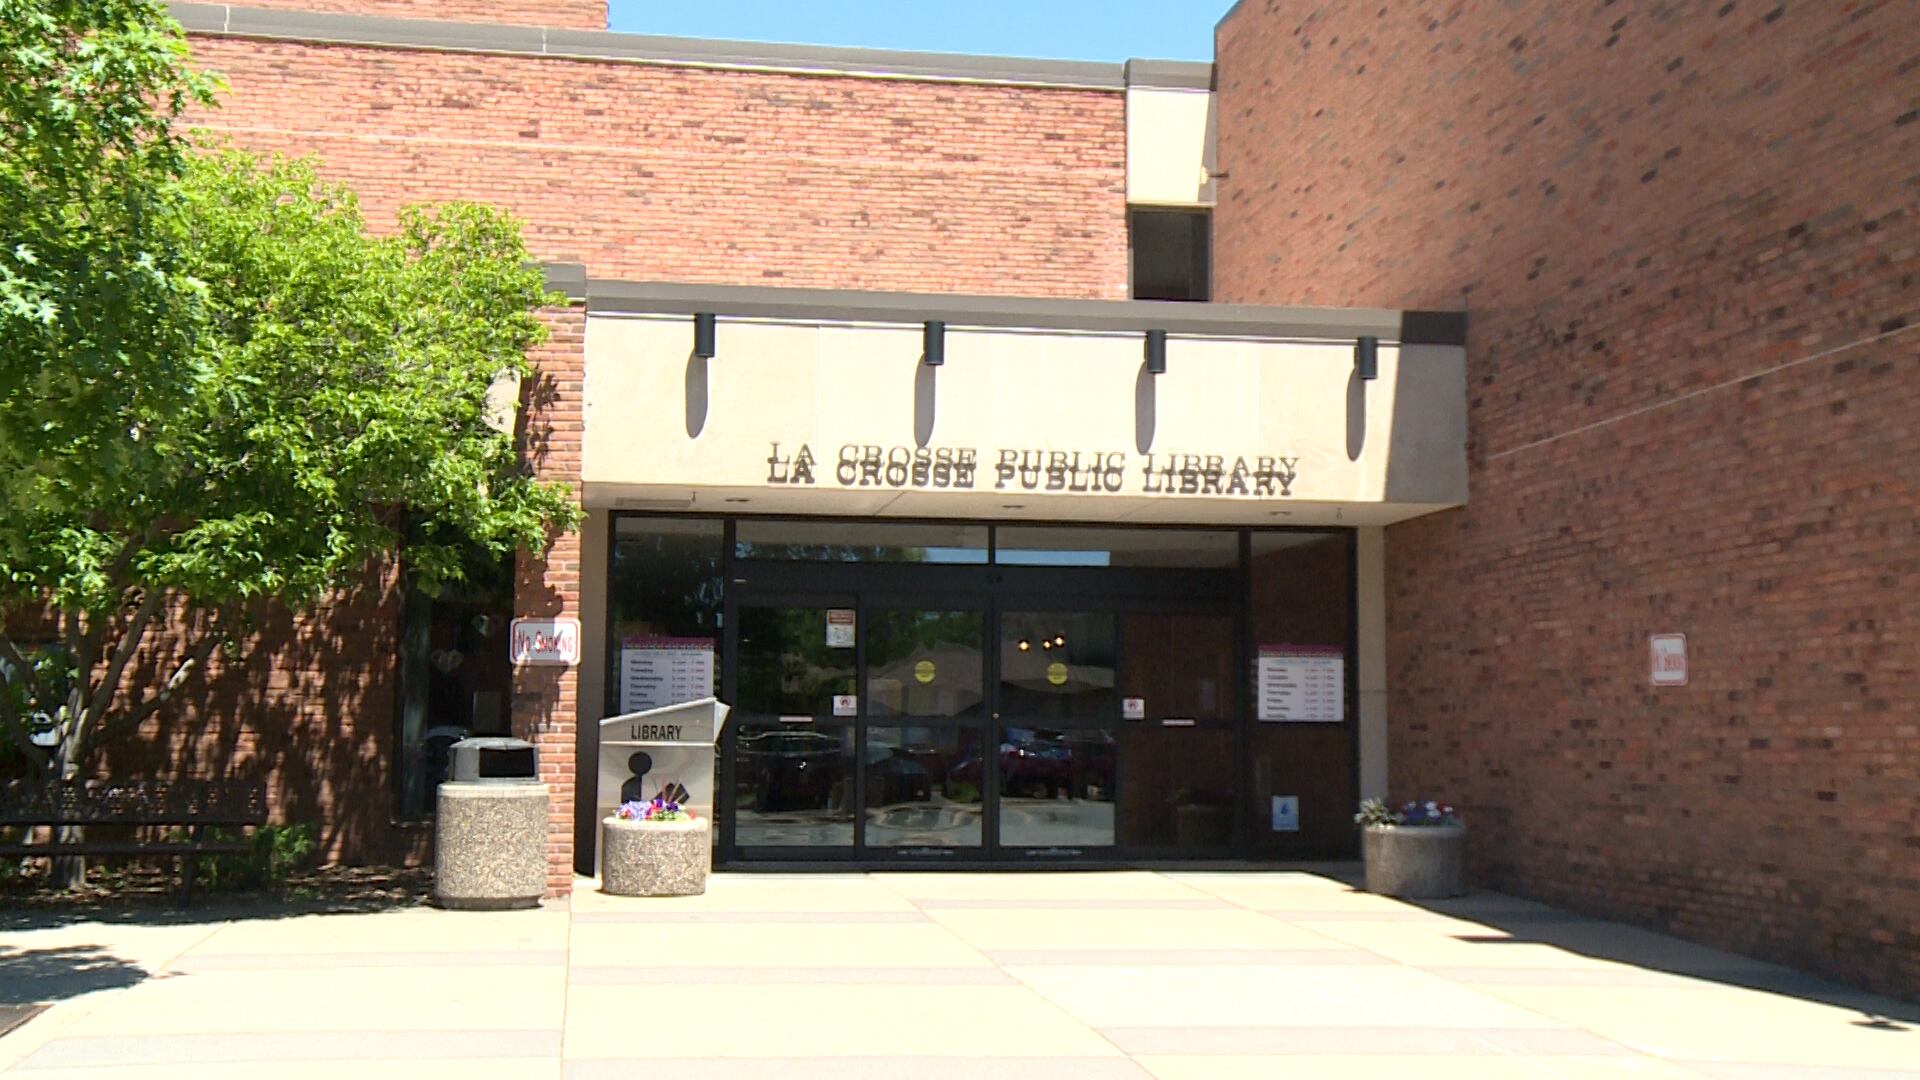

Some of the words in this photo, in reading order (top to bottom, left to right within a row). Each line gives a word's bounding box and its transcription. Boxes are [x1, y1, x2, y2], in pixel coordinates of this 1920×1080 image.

[767, 442, 816, 483] LA
[836, 444, 977, 488] CROSSE
[995, 449, 1126, 491] PUBLIC
[1142, 452, 1299, 495] LIBRARY
[631, 725, 682, 740] LIBRARY
